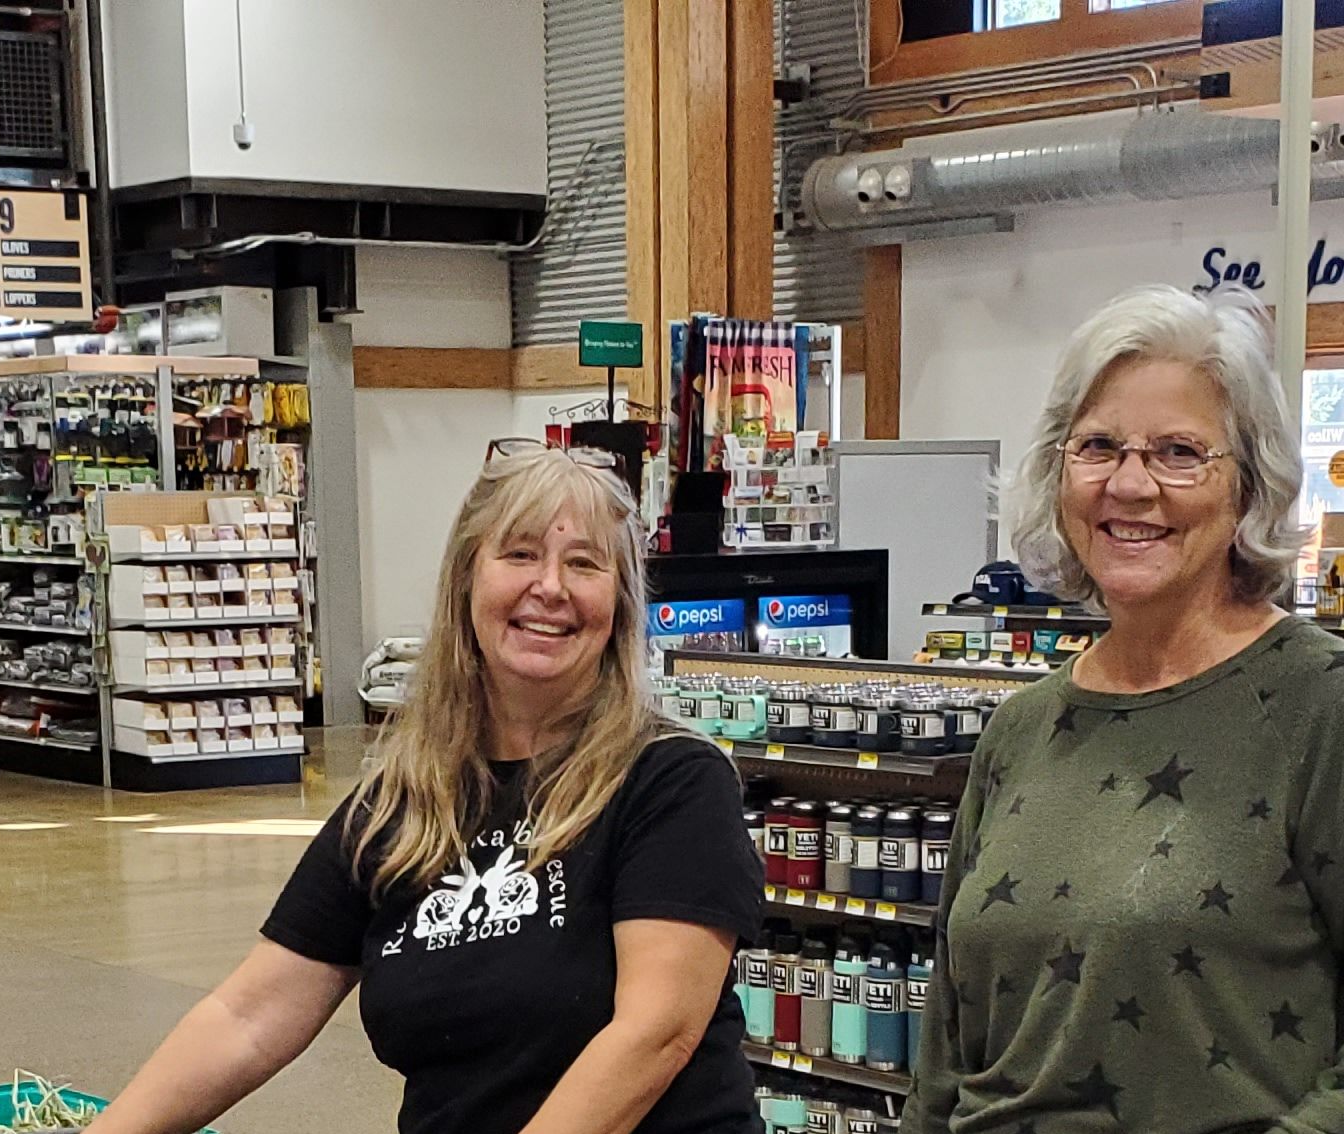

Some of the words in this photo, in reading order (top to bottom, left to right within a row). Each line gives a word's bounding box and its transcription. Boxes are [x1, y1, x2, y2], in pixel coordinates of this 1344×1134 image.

[1193, 248, 1266, 292] See
[678, 604, 723, 629] pepsi
[787, 598, 830, 622] pepsi
[797, 833, 819, 842] YETI
[546, 859, 567, 929] escue
[426, 929, 460, 951] EST.
[466, 916, 521, 943] 2020
[849, 1120, 877, 1133] YETI
